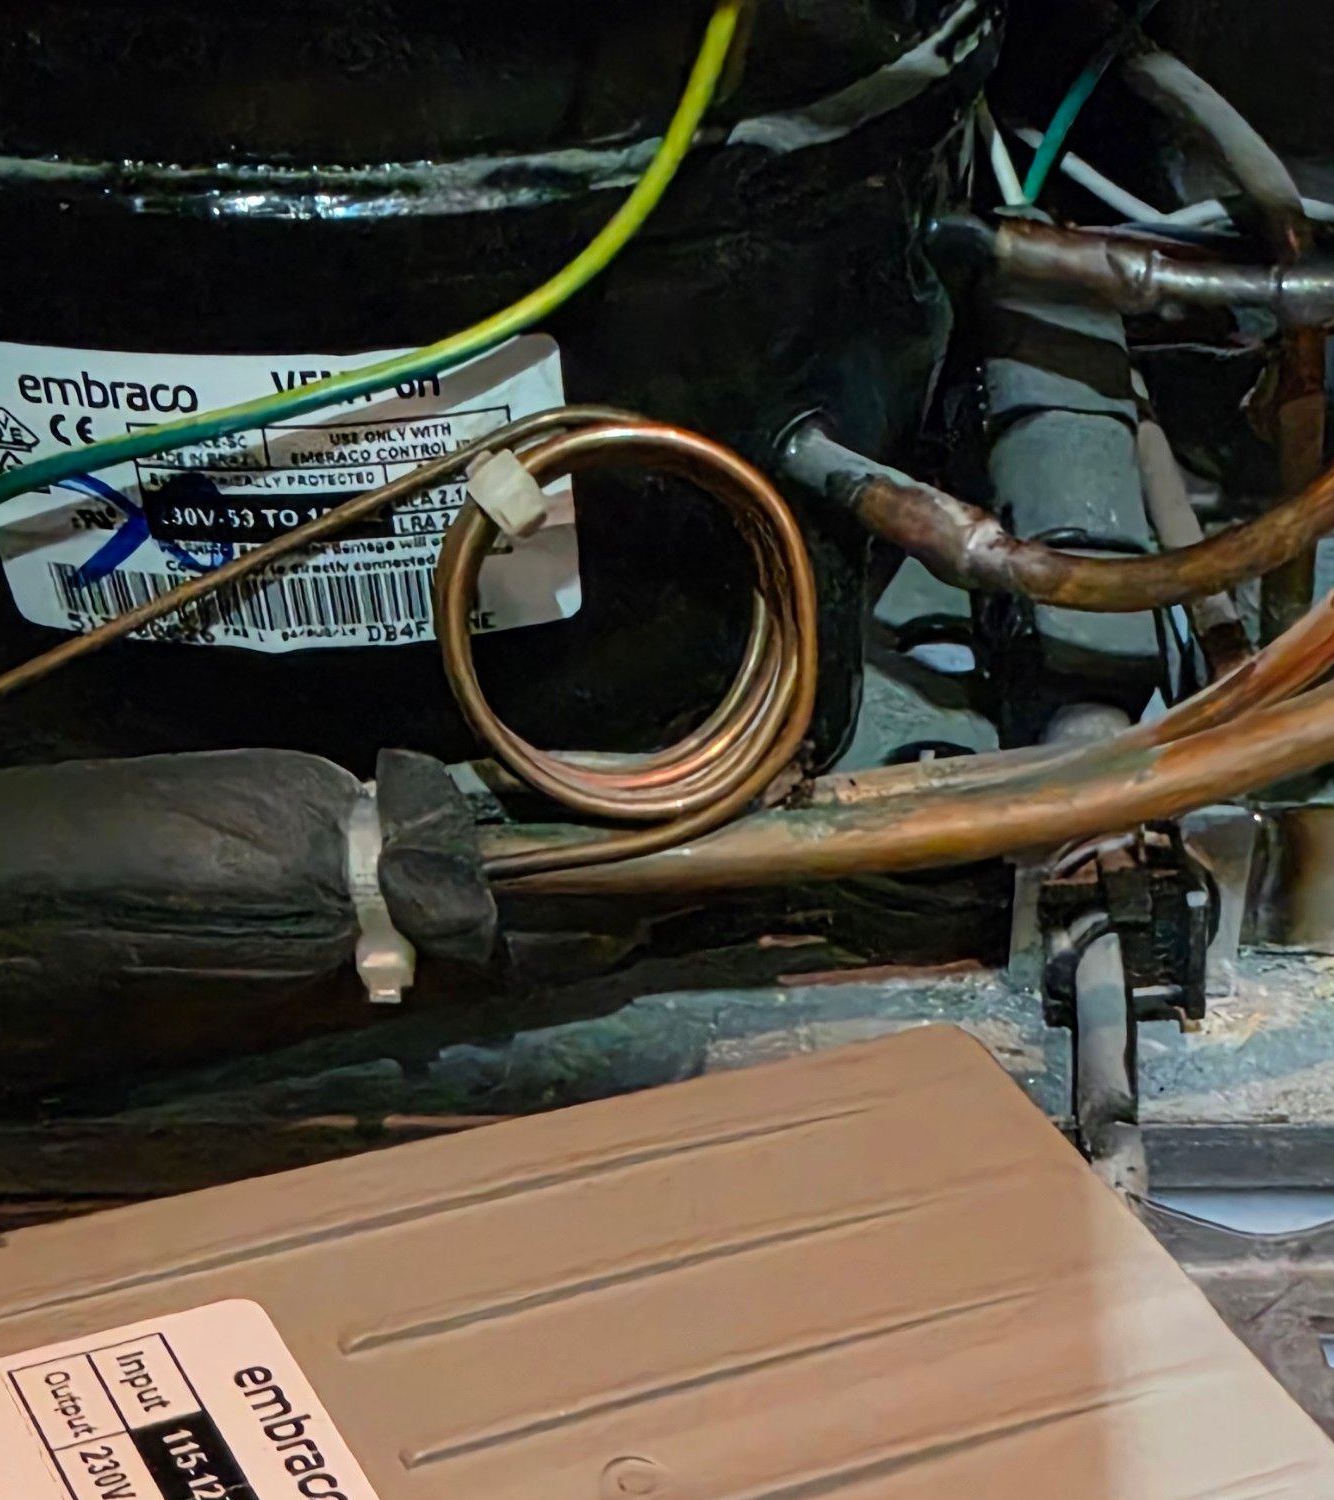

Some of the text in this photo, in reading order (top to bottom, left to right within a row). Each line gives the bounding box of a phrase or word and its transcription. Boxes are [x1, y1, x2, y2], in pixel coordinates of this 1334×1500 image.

[18, 371, 198, 413] embraco
[329, 422, 452, 446] USE ONLY WITH
[290, 446, 371, 465] EMBRACO
[376, 441, 447, 460] CONTROL
[287, 472, 376, 488] PROTECTED
[260, 508, 299, 529] TO
[116, 1351, 170, 1412] Input
[44, 1372, 97, 1438] Output
[79, 1446, 136, 1500] 230V
